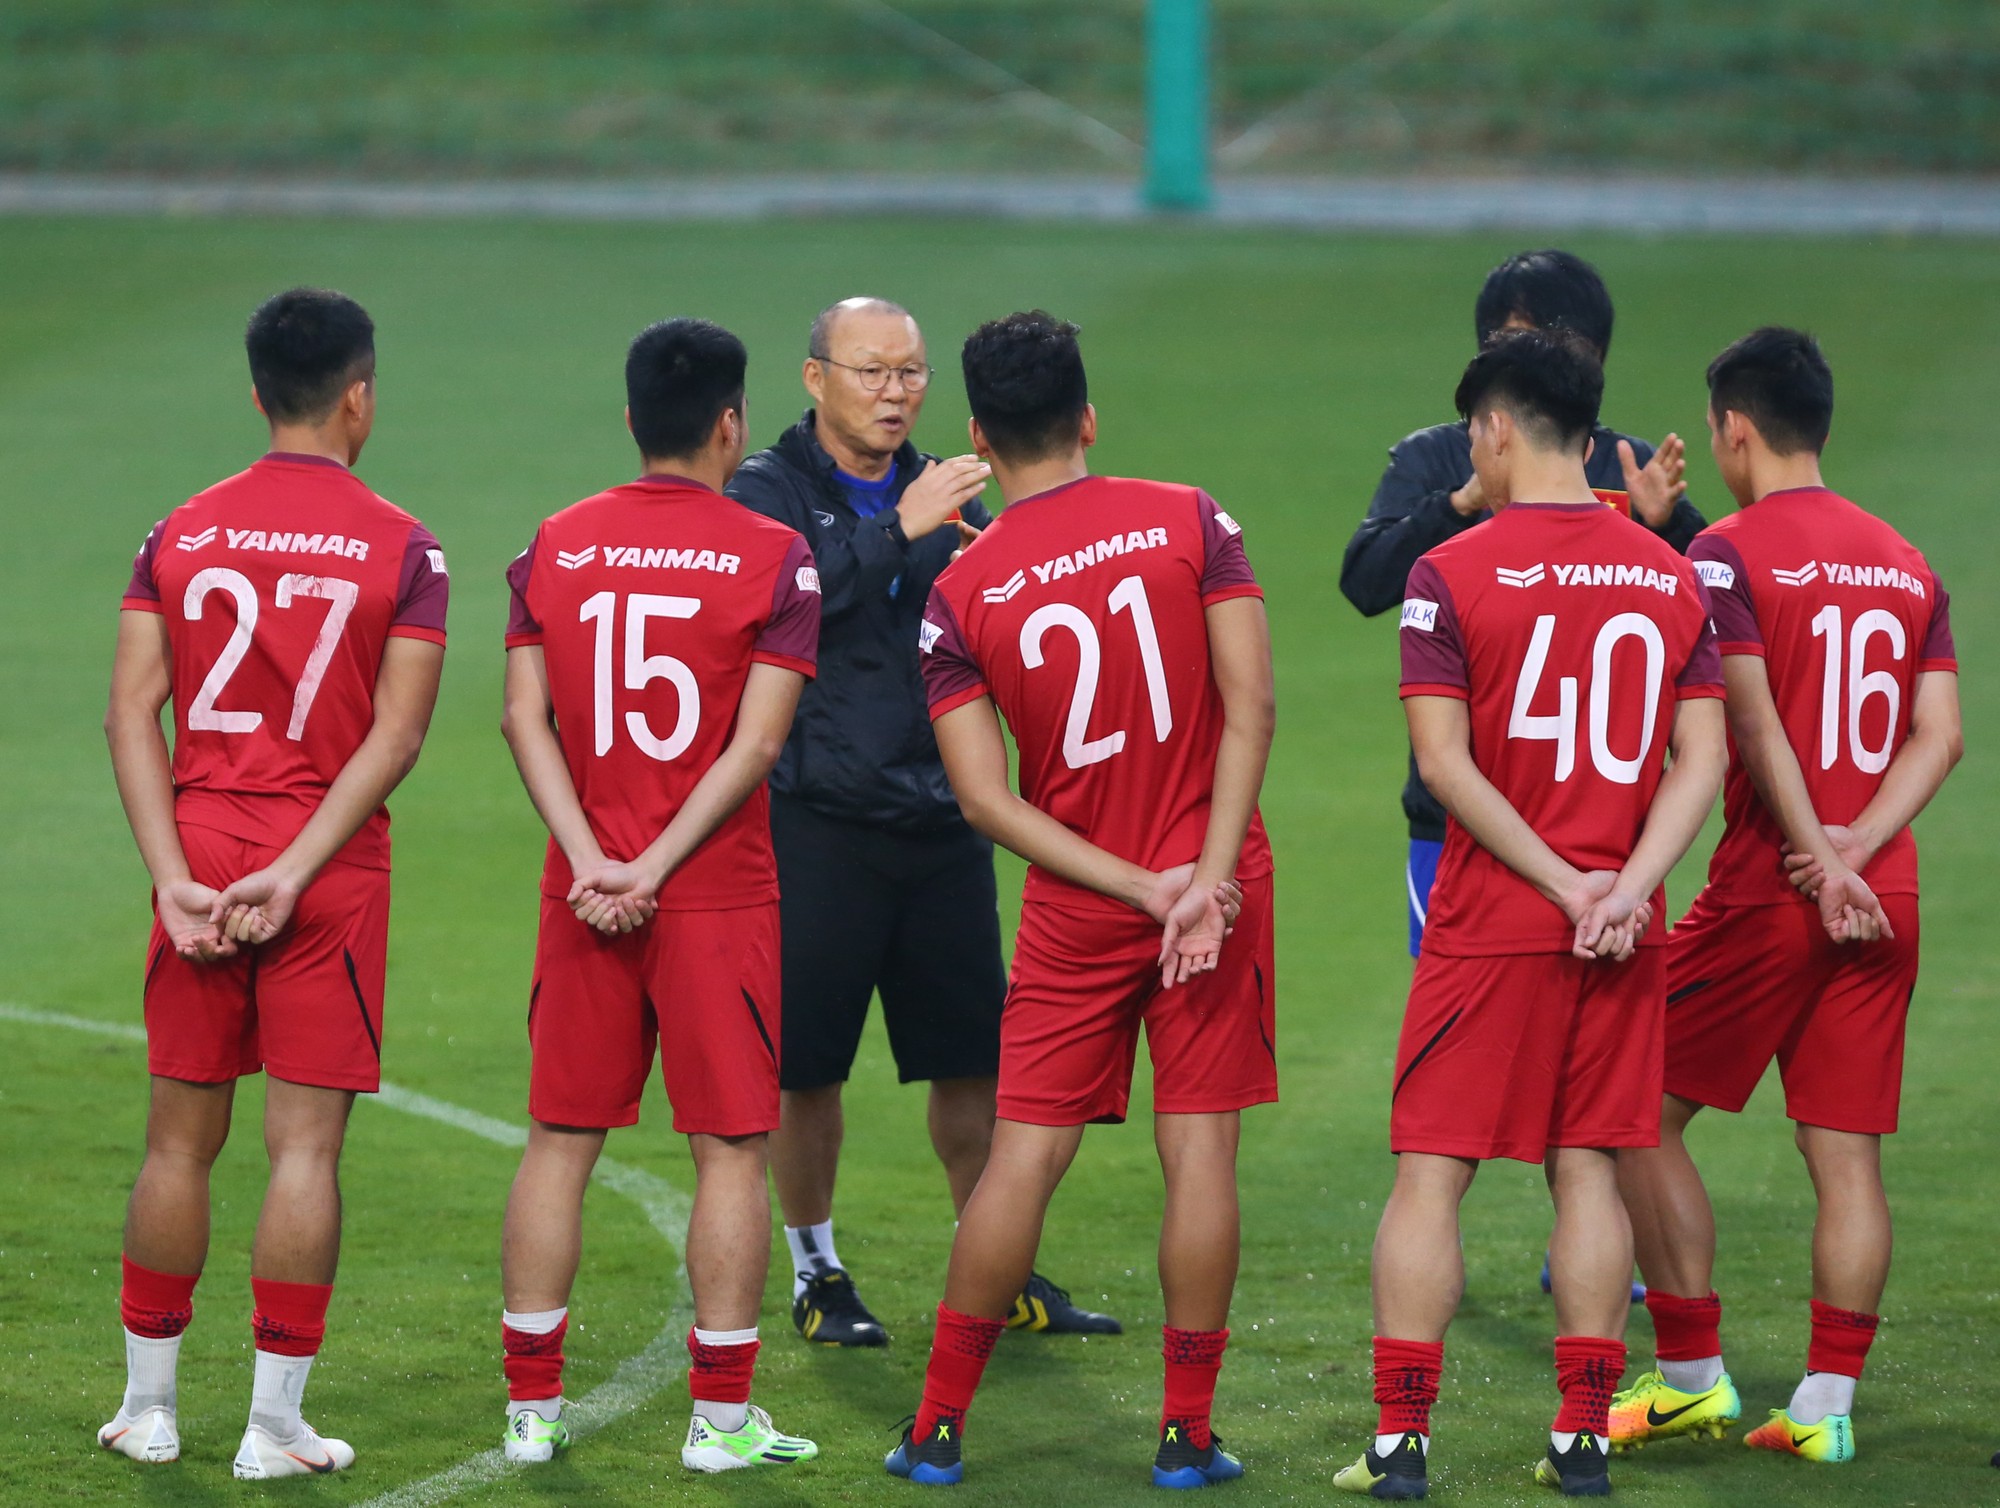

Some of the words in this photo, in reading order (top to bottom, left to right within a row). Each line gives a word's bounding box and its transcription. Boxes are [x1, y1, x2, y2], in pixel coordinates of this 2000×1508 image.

[225, 528, 369, 562] YANMAR
[604, 546, 741, 580] YANMAR
[1031, 527, 1169, 584] YANMAR
[1552, 564, 1679, 598] YANMAR
[1822, 562, 1925, 600] YANMAR
[183, 567, 360, 742] 27
[579, 592, 702, 762] 15
[1020, 576, 1173, 770] 21
[1508, 612, 1665, 785] 40
[1812, 604, 1906, 774] 16
